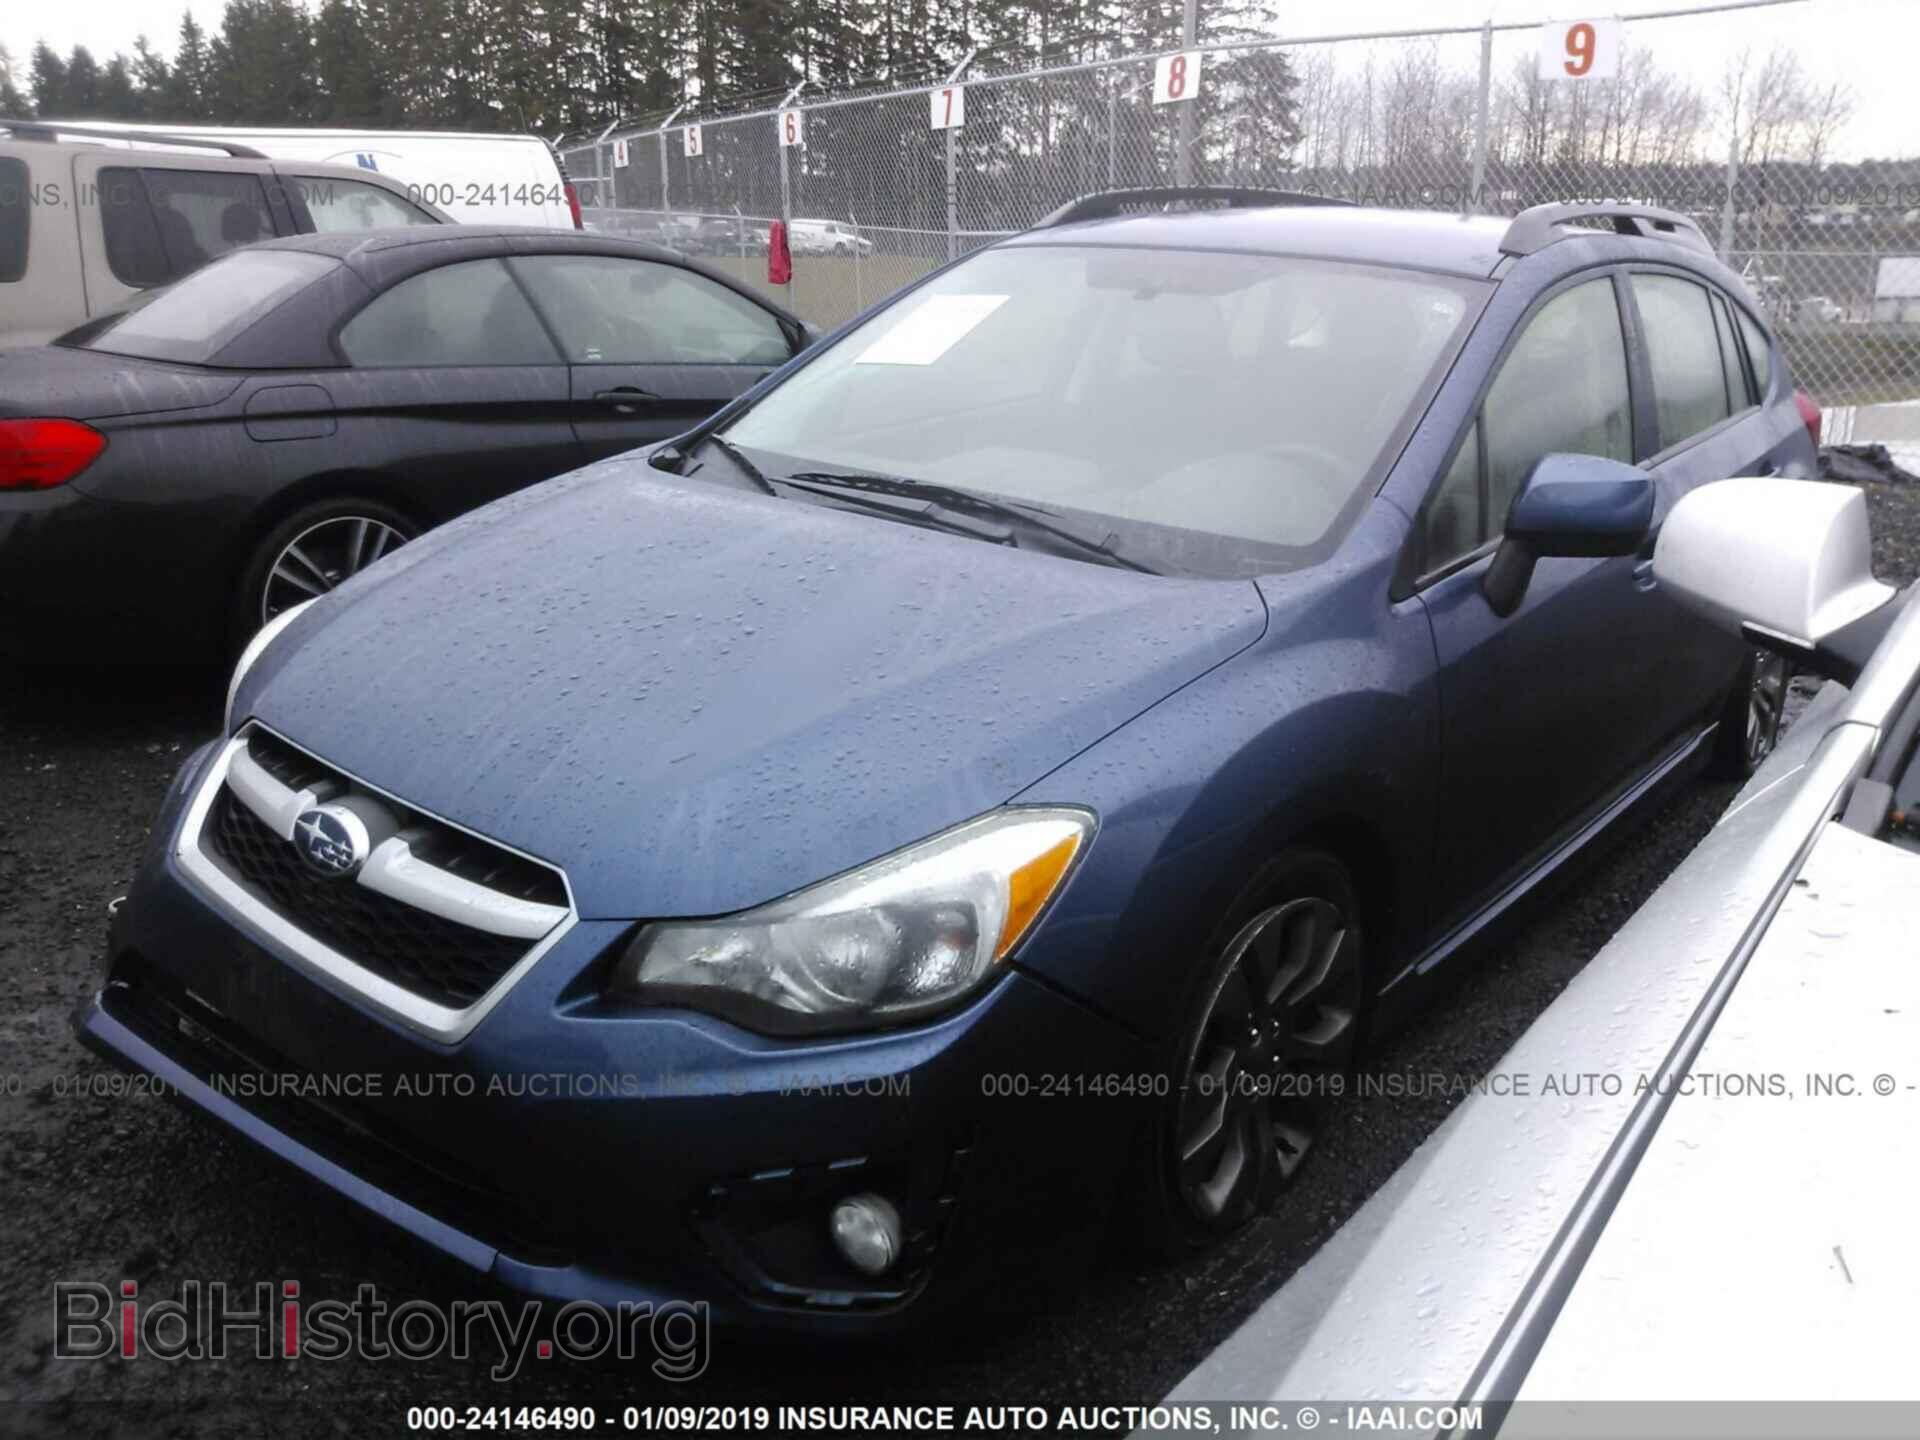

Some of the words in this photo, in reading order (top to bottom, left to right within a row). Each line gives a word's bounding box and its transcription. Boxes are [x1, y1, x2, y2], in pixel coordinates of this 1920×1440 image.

[1564, 23, 1596, 76] 9
[1168, 56, 1187, 99] 8
[942, 89, 953, 126] 7
[688, 127, 698, 155] 5
[785, 113, 796, 144] 6
